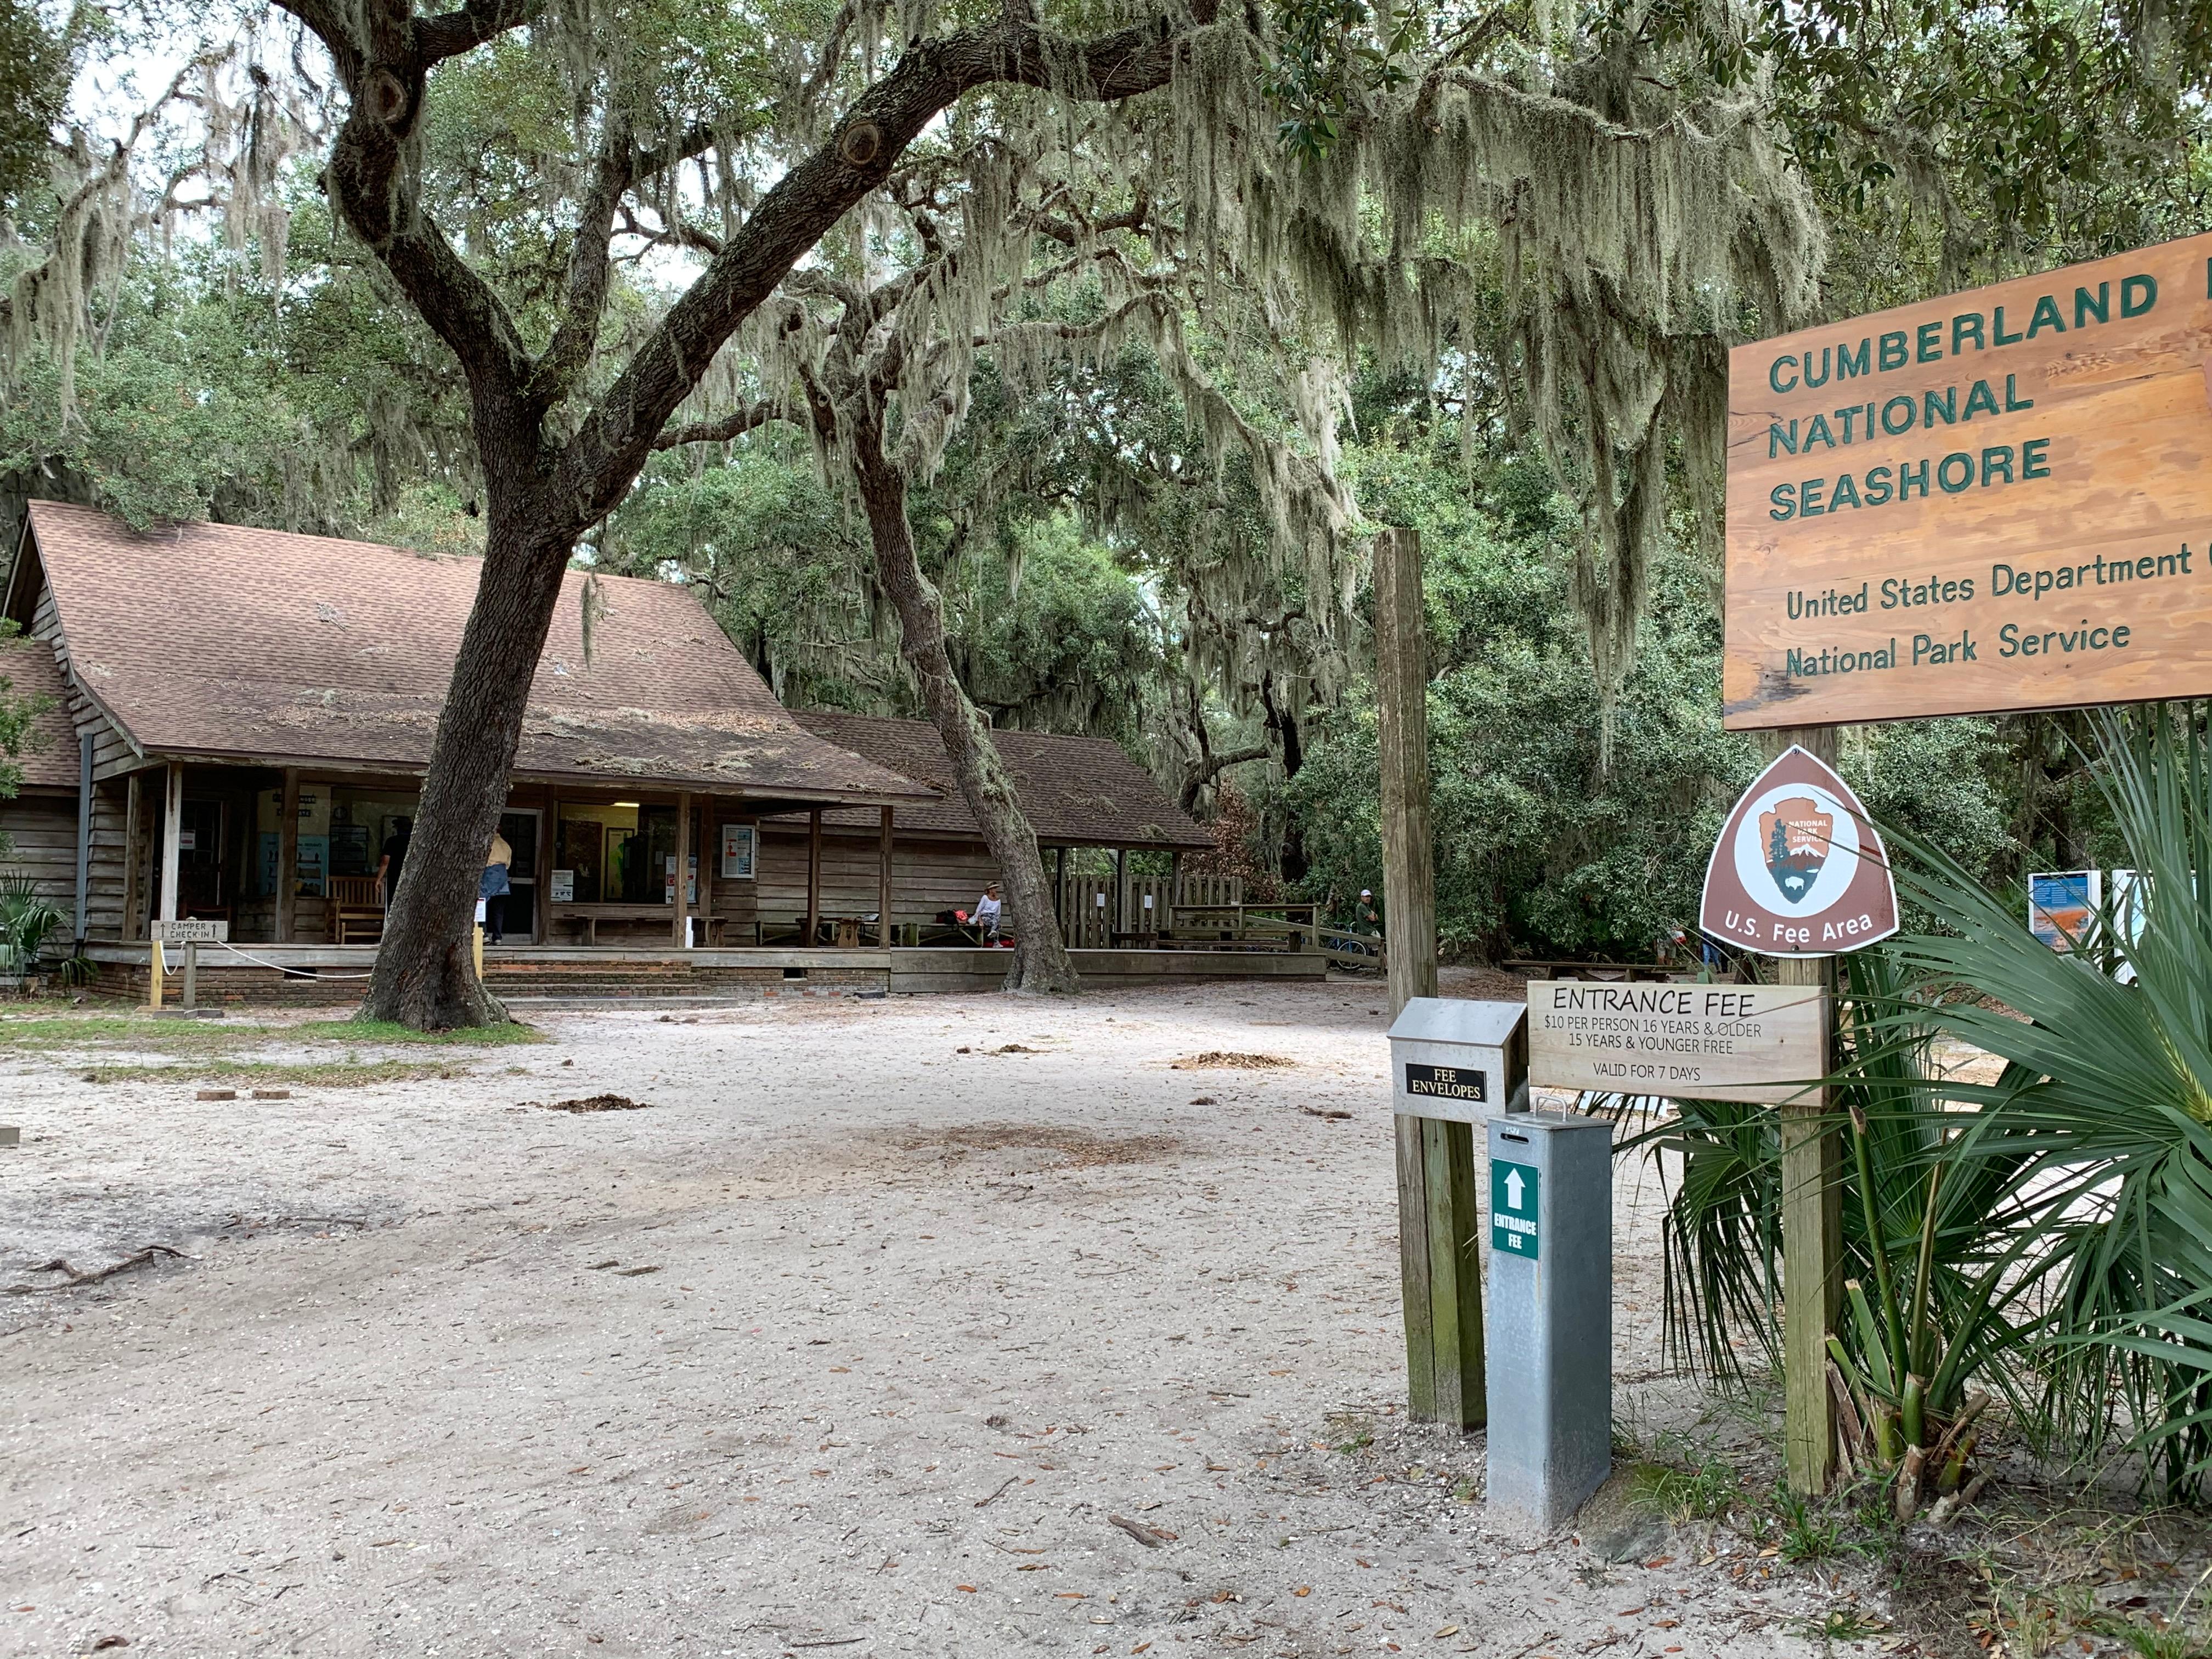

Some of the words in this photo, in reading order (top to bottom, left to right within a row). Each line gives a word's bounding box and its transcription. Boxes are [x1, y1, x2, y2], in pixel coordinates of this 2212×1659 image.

[1769, 274, 2159, 394] CUMBERLAND
[1769, 373, 2034, 459] NATIONAL
[1769, 438, 2051, 522] SEASHORE
[1787, 583, 1868, 621] United
[1880, 575, 1974, 610] States
[1992, 543, 2193, 602] Department
[1786, 638, 1895, 679] National
[1912, 630, 1977, 665] Park
[1999, 620, 2131, 658] Service
[1725, 910, 1760, 939] U.S.
[1773, 923, 1810, 943] Fee
[1822, 913, 1872, 941] Area
[1553, 988, 1692, 1014] ENTRANCE
[1705, 992, 1755, 1017] FEE
[1545, 1014, 1565, 1029] $10
[1567, 1017, 1588, 1030] PER
[1592, 1018, 1639, 1032] PERSON
[1643, 1020, 1657, 1033] 16
[1661, 1021, 1700, 1035] YEARS
[1703, 1023, 1714, 1035] &
[1717, 1022, 1762, 1038] OLDER
[1569, 1033, 1582, 1046] 15
[1586, 1034, 1622, 1048] YEARS
[1626, 1035, 1635, 1048] &
[1638, 1036, 1700, 1053] YOUNGER
[1703, 1040, 1733, 1054] FREE
[1434, 1068, 1457, 1082] FEE
[1593, 1062, 1627, 1077] VALID
[1630, 1065, 1655, 1079] FOR
[1658, 1066, 1666, 1079] 7
[1669, 1067, 1701, 1081] DAYS
[1412, 1080, 1481, 1099] ENVELOPES
[1494, 1213, 1537, 1236] ENTRANCE
[1508, 1233, 1522, 1249] FEE
